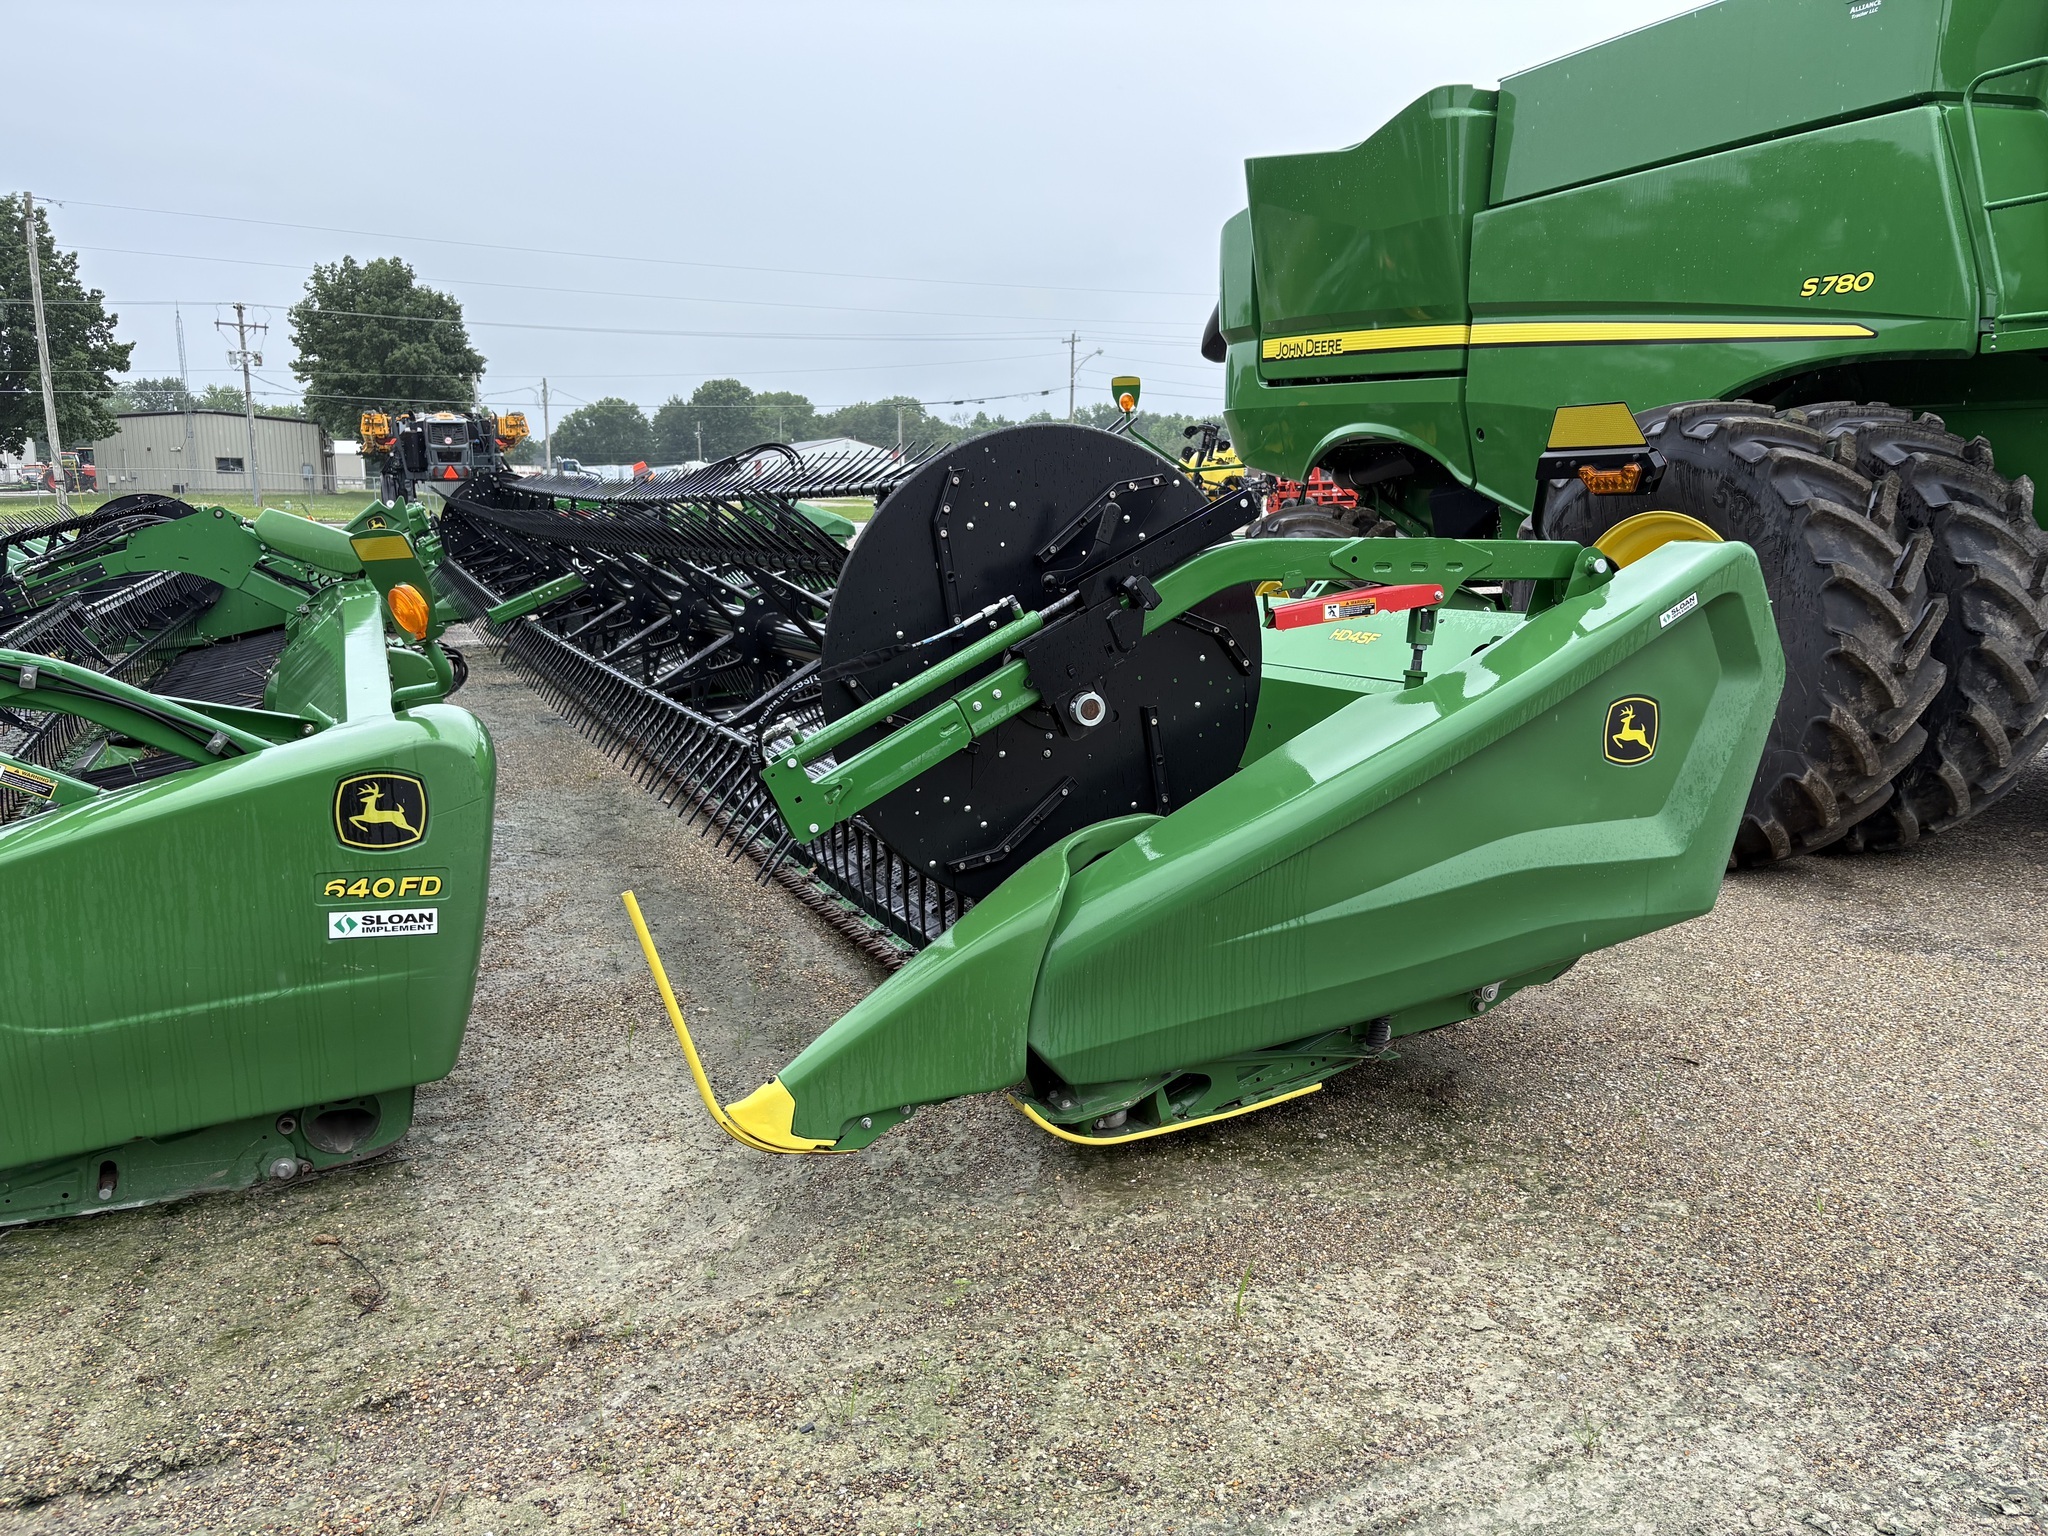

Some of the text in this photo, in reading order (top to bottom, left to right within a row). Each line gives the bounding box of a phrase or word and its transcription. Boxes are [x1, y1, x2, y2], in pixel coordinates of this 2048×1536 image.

[1800, 271, 1875, 297] S780
[1276, 339, 1343, 357] JOHN DEERE
[1670, 596, 1695, 615] SLOAN
[1328, 628, 1382, 645] HD45F
[21, 770, 50, 784] WARNING
[323, 876, 442, 899] 640FD
[361, 913, 434, 926] SLOAN
[361, 923, 434, 933] IMPLEMENT
